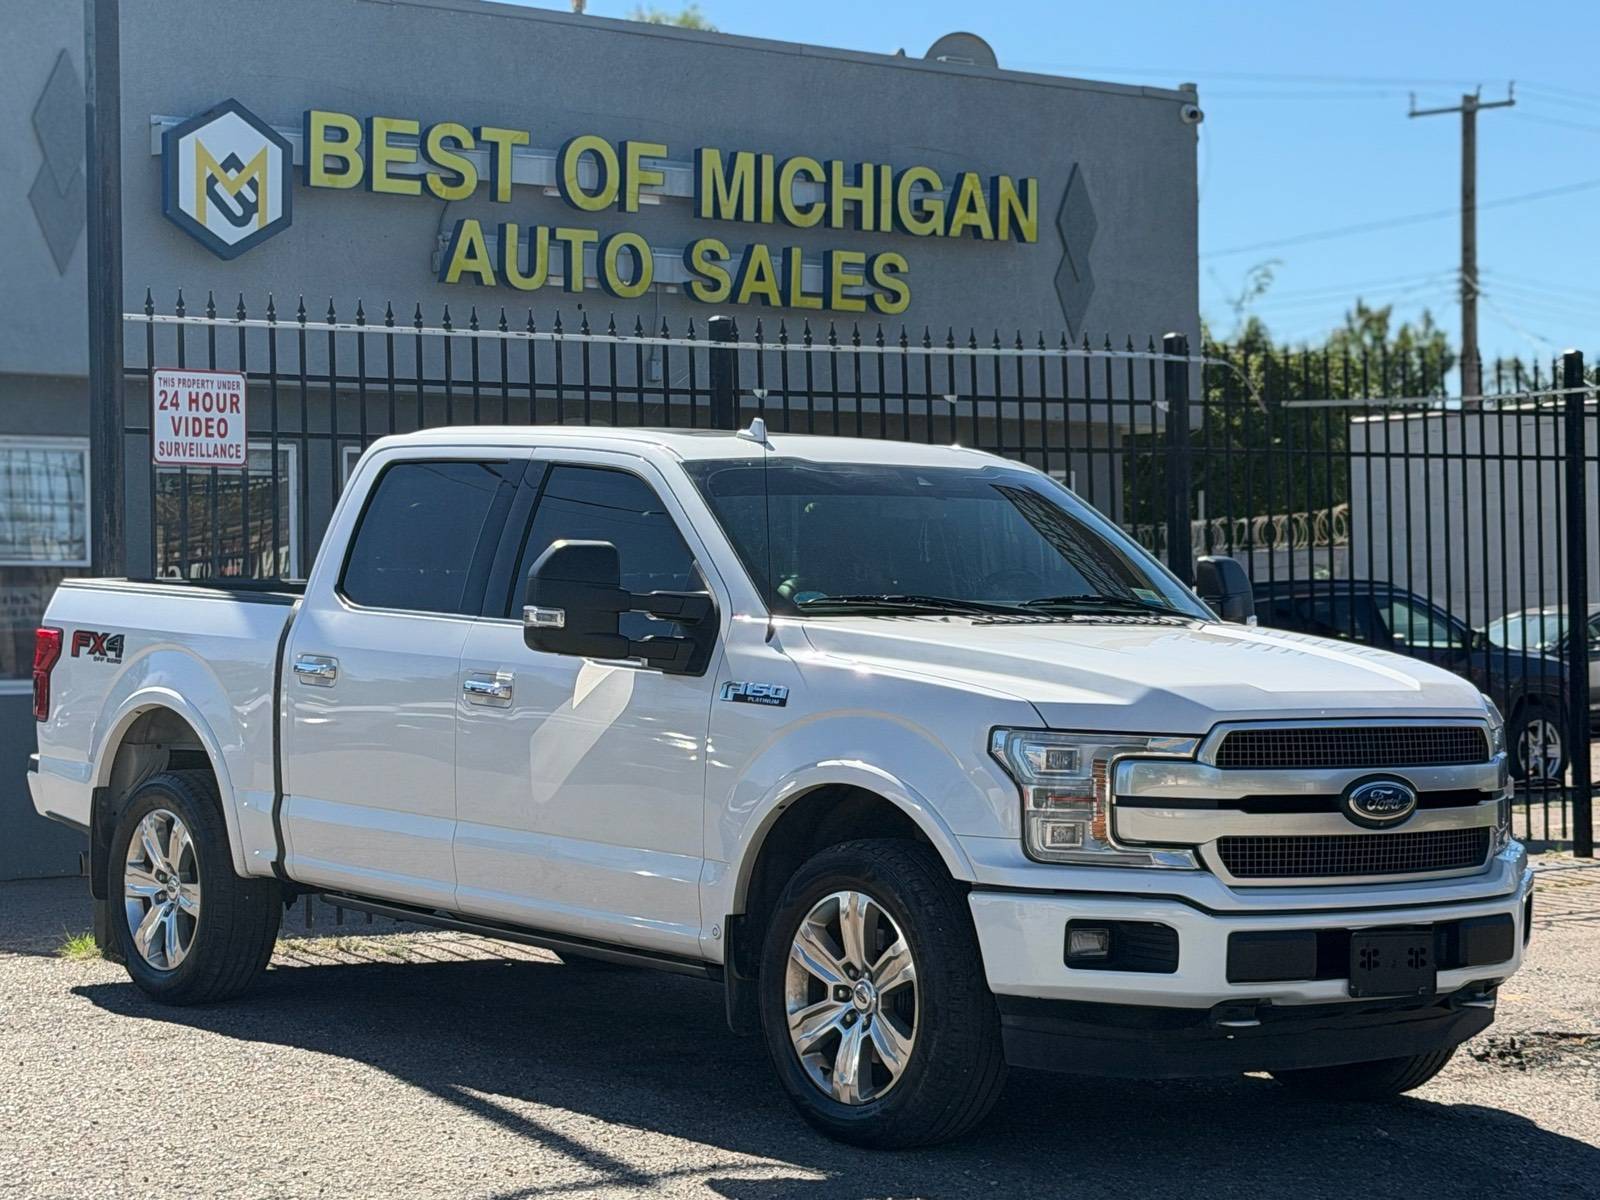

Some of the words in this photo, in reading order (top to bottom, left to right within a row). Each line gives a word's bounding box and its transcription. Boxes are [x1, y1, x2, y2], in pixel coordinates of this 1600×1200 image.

[304, 109, 530, 202] BEST
[556, 134, 668, 213] OF
[695, 147, 1039, 243] MICHIGAN
[440, 218, 654, 298] AUTO
[684, 237, 912, 315] SALES
[158, 377, 175, 387] THIS
[178, 378, 214, 389] PROPERTY
[217, 381, 240, 391] UNDER
[159, 389, 179, 411] 24
[188, 391, 240, 413] HOUR
[171, 416, 228, 438] VIDEO
[159, 441, 241, 458] SURVEILLANCE
[71, 630, 124, 657] FX4
[1366, 789, 1409, 810] Ford
